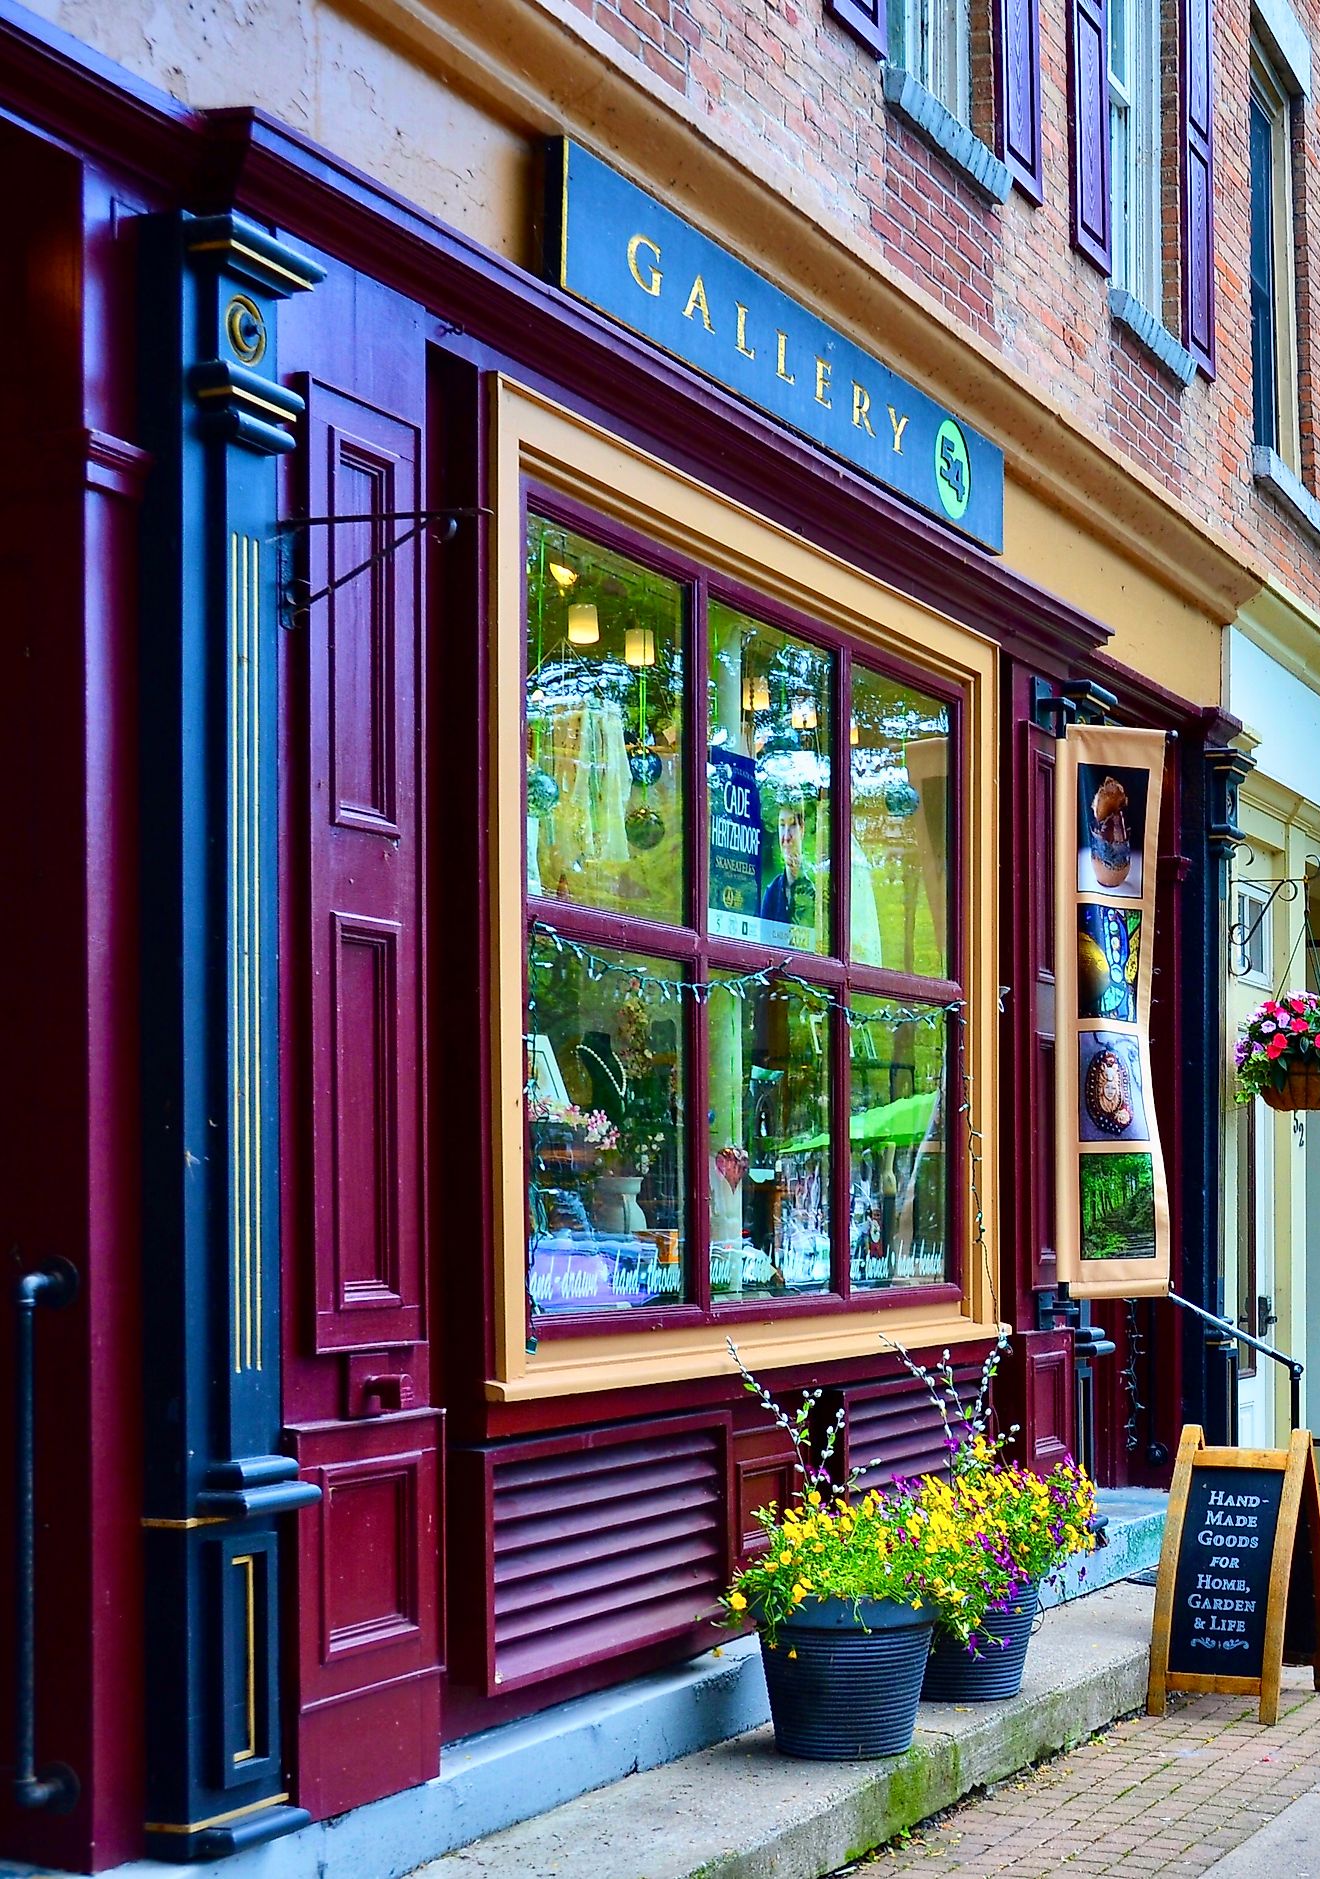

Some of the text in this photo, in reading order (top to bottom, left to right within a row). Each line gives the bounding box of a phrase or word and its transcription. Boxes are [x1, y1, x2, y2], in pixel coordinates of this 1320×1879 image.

[626, 233, 966, 503] GALLERY 54
[723, 781, 751, 818] CADE
[711, 814, 761, 856] HERTZENDORF
[715, 855, 756, 875] SKANEATELES
[1293, 1110, 1305, 1148] 52
[1207, 1490, 1270, 1508] HAND-
[1204, 1510, 1258, 1528] MADE
[1197, 1529, 1259, 1549] GOODS
[1209, 1556, 1240, 1569] FOR
[1196, 1573, 1251, 1594] HOME,
[1187, 1593, 1257, 1613] GARDEN
[1193, 1615, 1246, 1633] & LIFE
